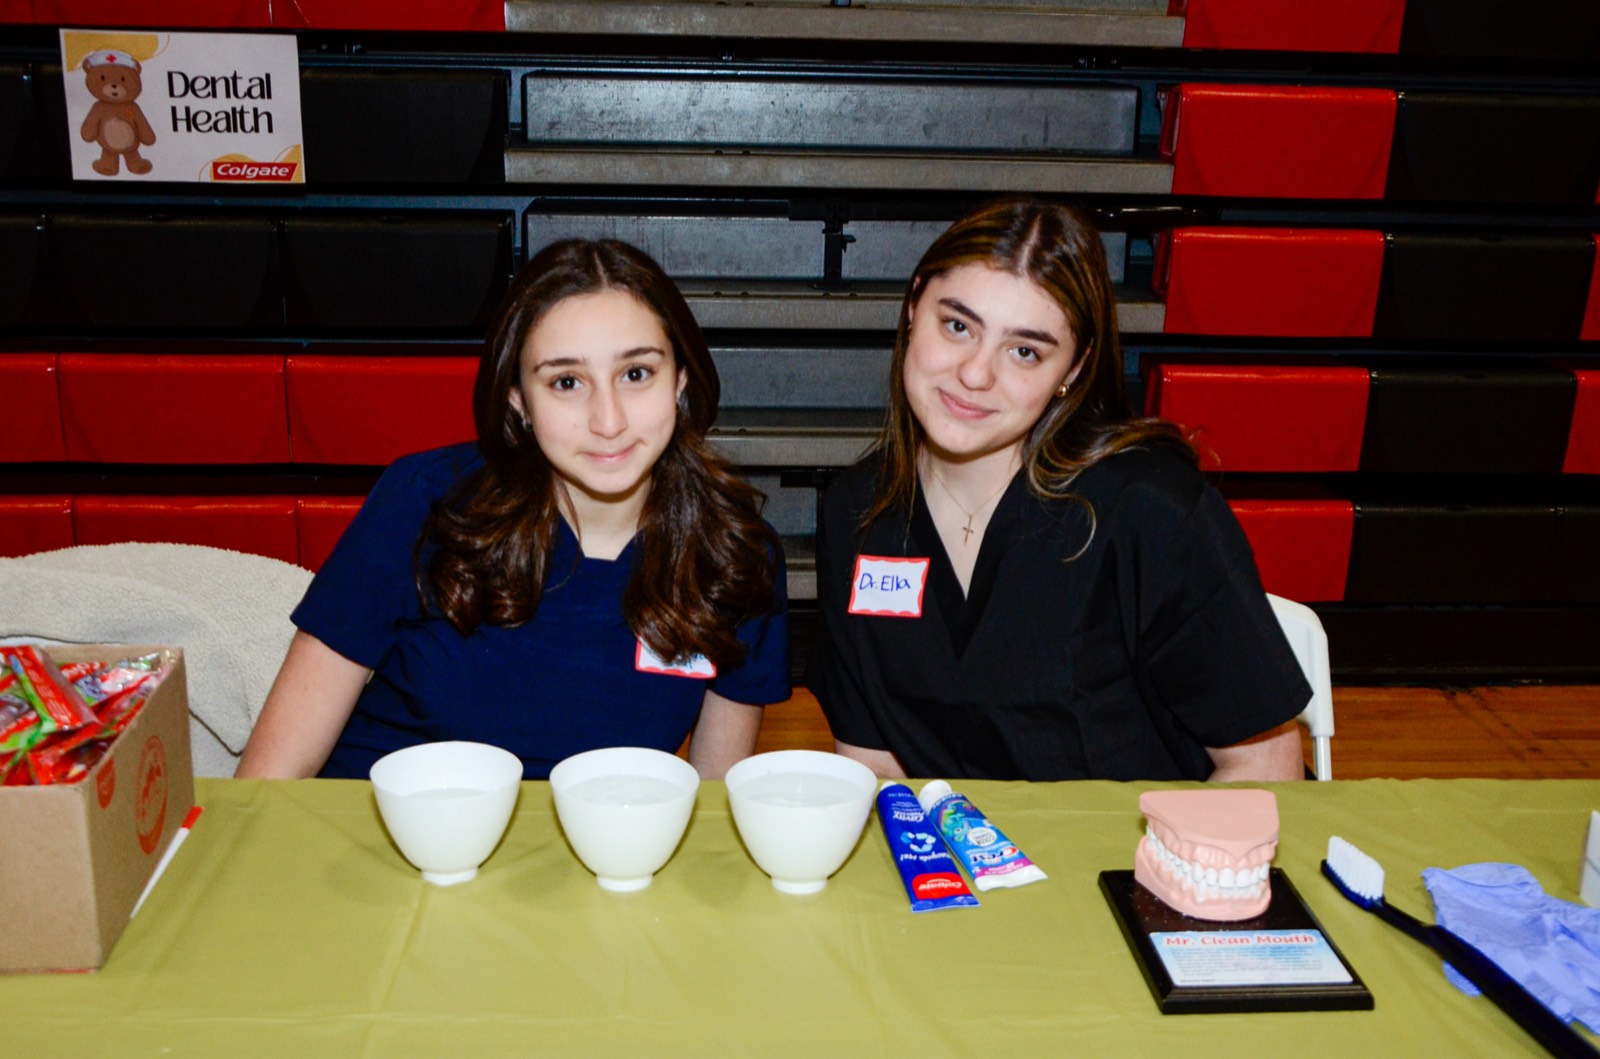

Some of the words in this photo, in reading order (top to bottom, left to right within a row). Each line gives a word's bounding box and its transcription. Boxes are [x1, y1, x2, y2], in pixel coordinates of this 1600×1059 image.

[167, 70, 272, 100] Dental
[170, 105, 274, 134] Health
[216, 163, 290, 178] Colgate
[859, 572, 878, 590] Dr.
[880, 574, 911, 592] Ella
[973, 846, 1018, 863] Crest
[918, 880, 963, 891] Colgate
[1165, 936, 1195, 946] Mr.
[1201, 935, 1250, 945] Clean
[1256, 934, 1315, 944] Mouth
